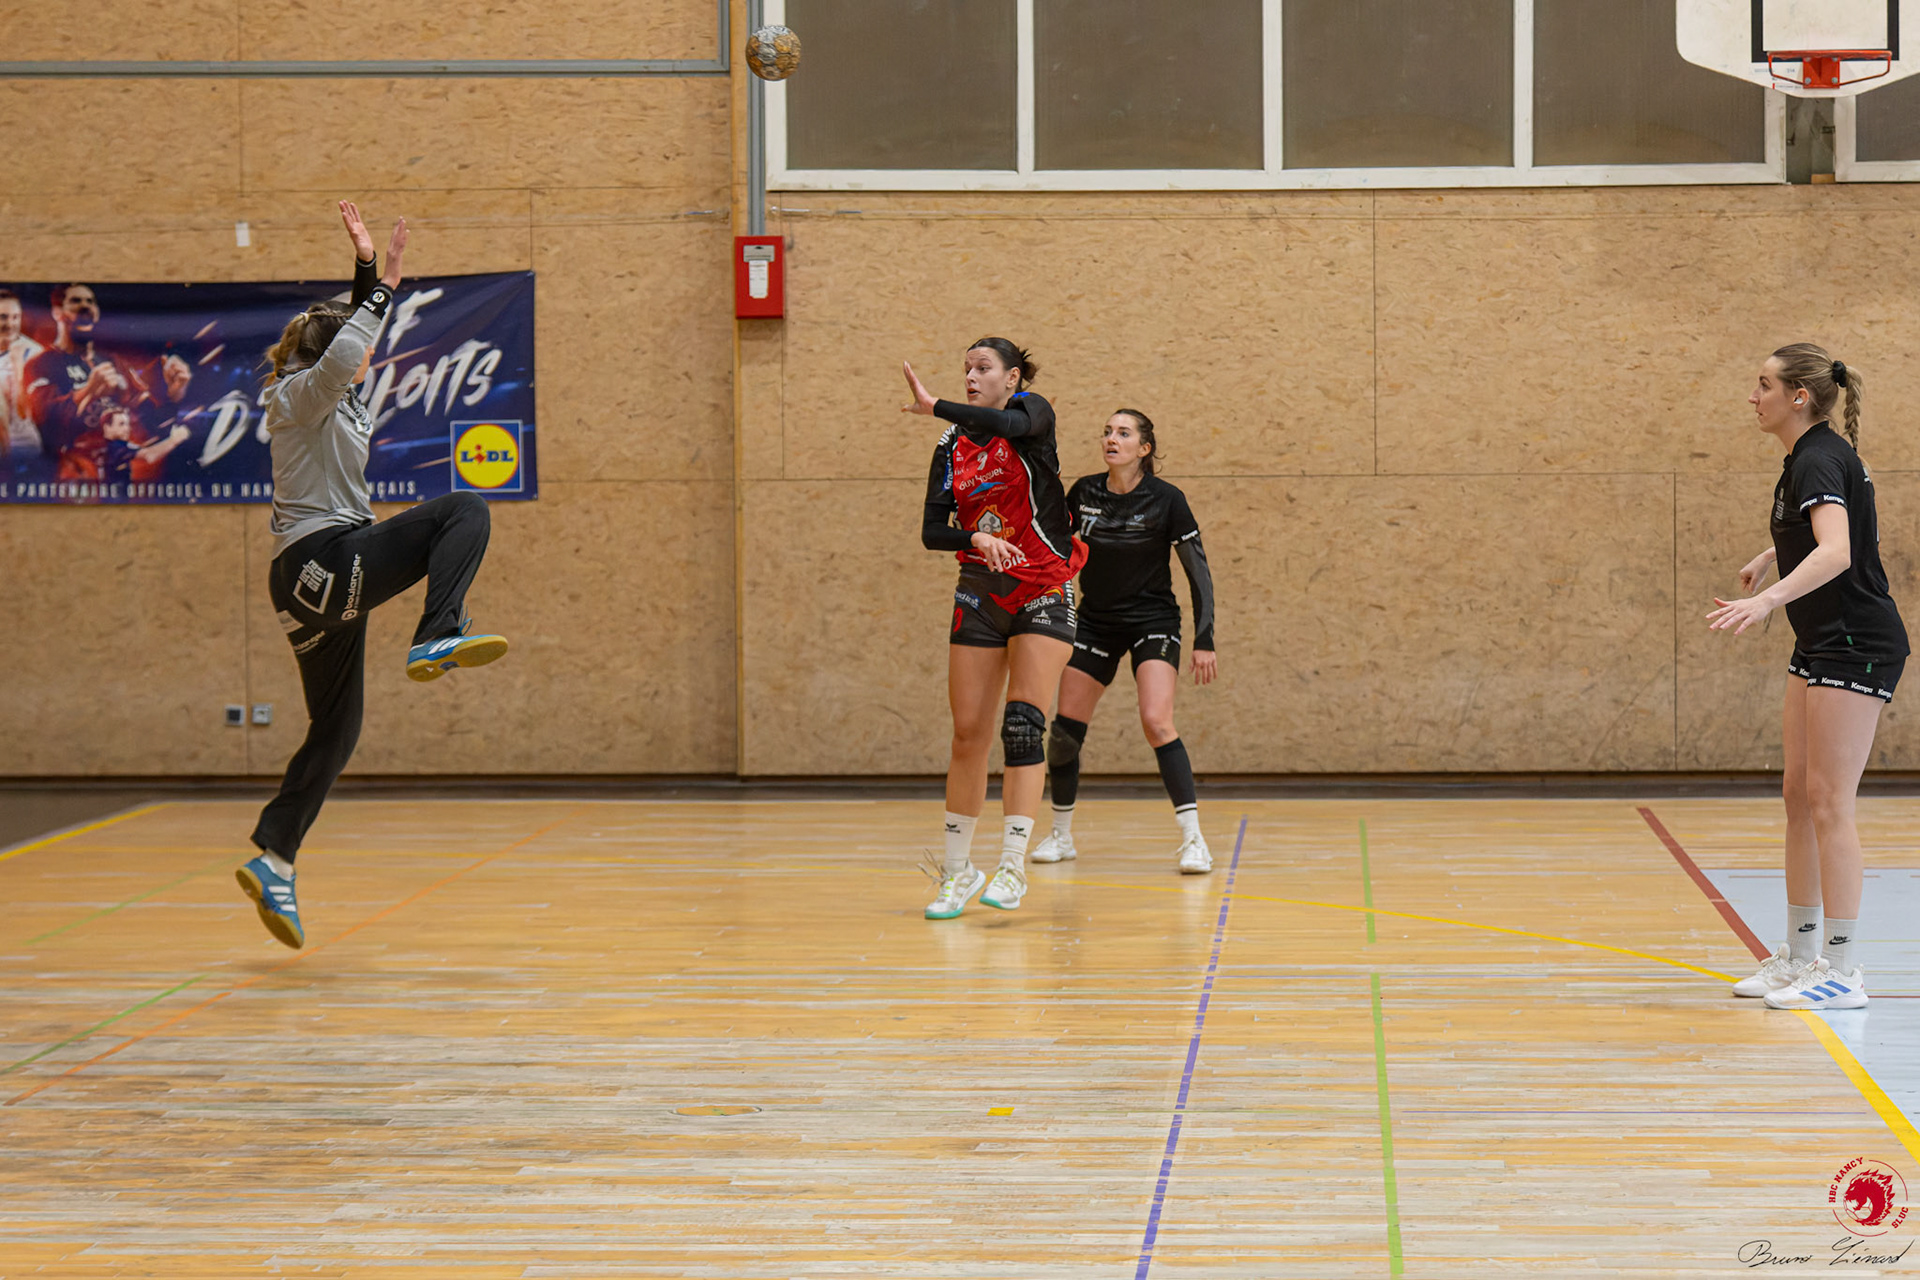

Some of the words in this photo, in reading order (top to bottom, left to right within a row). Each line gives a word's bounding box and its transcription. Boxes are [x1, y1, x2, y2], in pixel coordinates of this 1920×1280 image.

[977, 451, 988, 470] 9
[16, 483, 118, 498] PARTENAIRE
[126, 483, 203, 498] OFFICIEL
[211, 483, 232, 498] DU
[959, 478, 975, 490] Guy
[1079, 504, 1102, 515] Kempa
[1081, 515, 1098, 537] 77
[344, 553, 361, 610] boulanger
[1031, 617, 1052, 626] SELECT
[1821, 677, 1845, 687] Kempa
[1850, 681, 1874, 694] Kempa
[1877, 688, 1892, 699] Kemp
